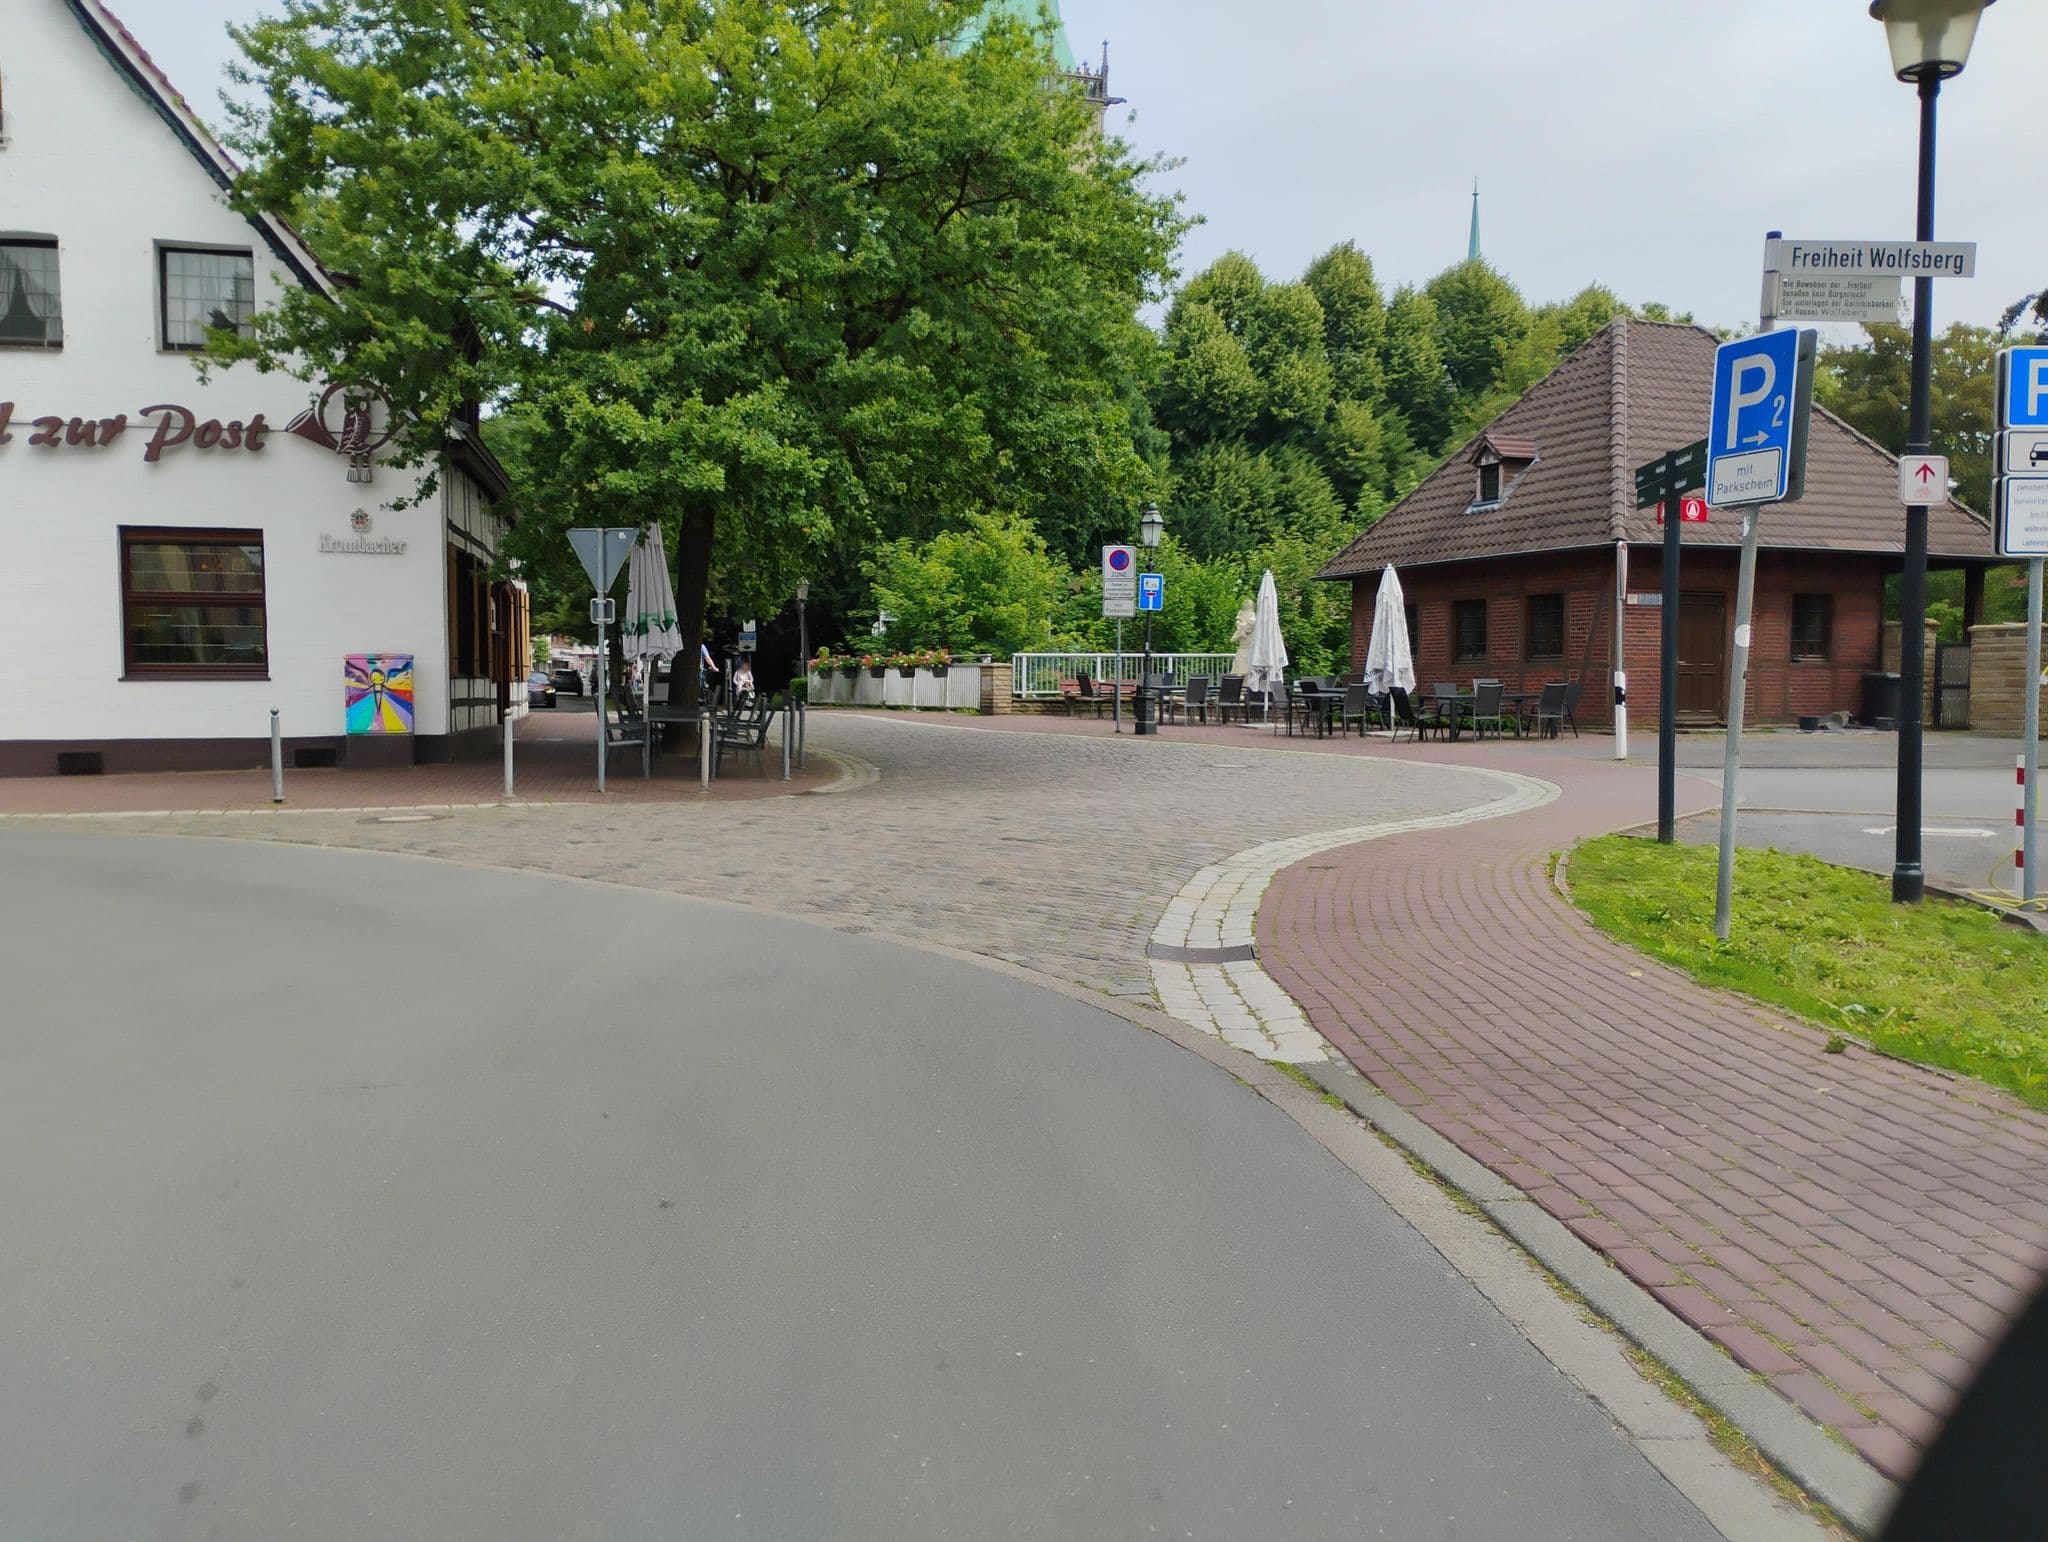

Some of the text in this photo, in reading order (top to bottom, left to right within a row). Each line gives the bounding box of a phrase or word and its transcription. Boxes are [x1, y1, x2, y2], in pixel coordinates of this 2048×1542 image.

[1792, 246, 1965, 275] Freiheit Wolfsberg
[1726, 353, 1786, 450] P 2
[28, 413, 128, 448] zur
[138, 403, 269, 463] Post
[1736, 464, 1753, 477] mit
[1716, 478, 1773, 496] Parkschein
[319, 533, 408, 555] Krombacher
